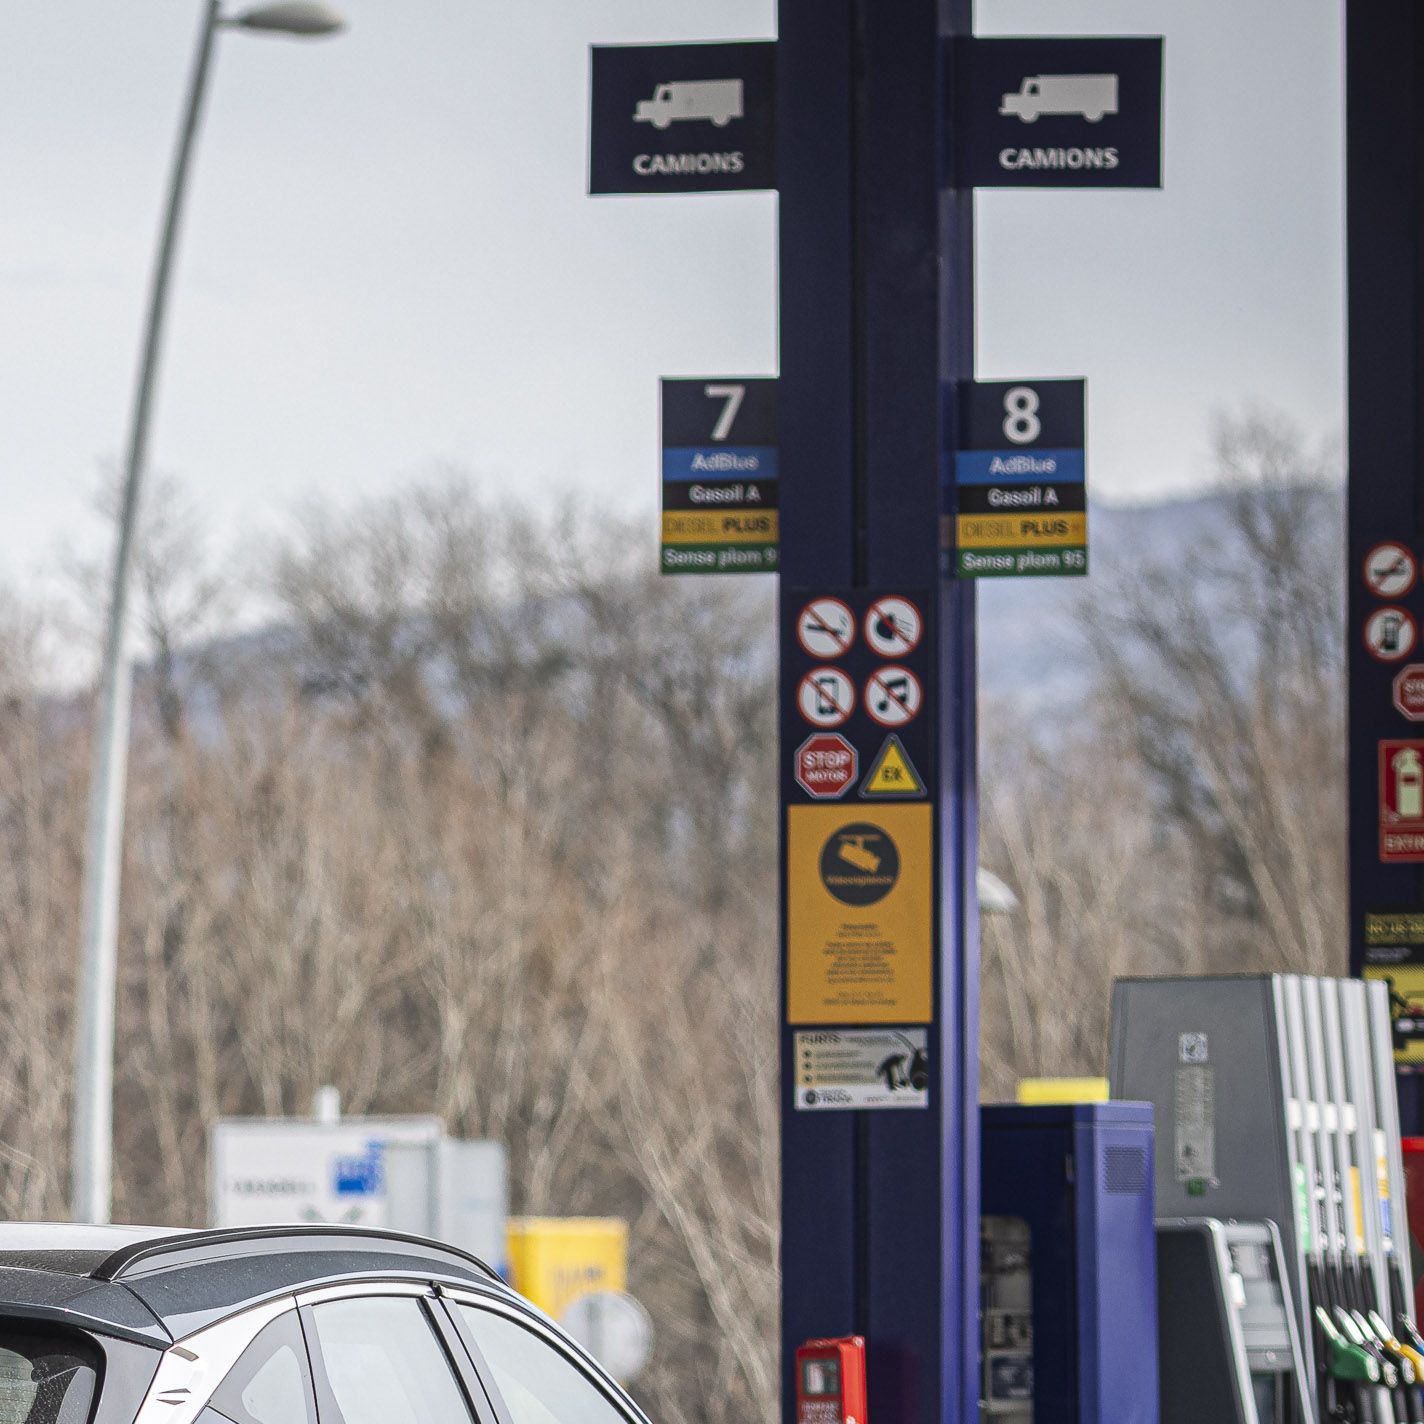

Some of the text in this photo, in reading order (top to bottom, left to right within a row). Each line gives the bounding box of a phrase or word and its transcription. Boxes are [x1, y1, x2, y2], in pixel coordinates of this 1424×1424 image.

[633, 151, 744, 176] CAMIONS
[998, 147, 1119, 171] CAMIONS
[704, 384, 746, 441] 7
[1002, 386, 1041, 444] 8
[691, 453, 759, 472] AdBlue
[989, 456, 1056, 475] AdBlue
[688, 484, 761, 503] Gasoil A
[987, 487, 1059, 506] Gasoil A
[663, 549, 716, 567] Sense
[718, 548, 762, 570] plom
[962, 552, 1014, 569] Sense
[1017, 551, 1060, 571] plom
[803, 750, 850, 767] STOP
[806, 769, 847, 782] MOTOR
